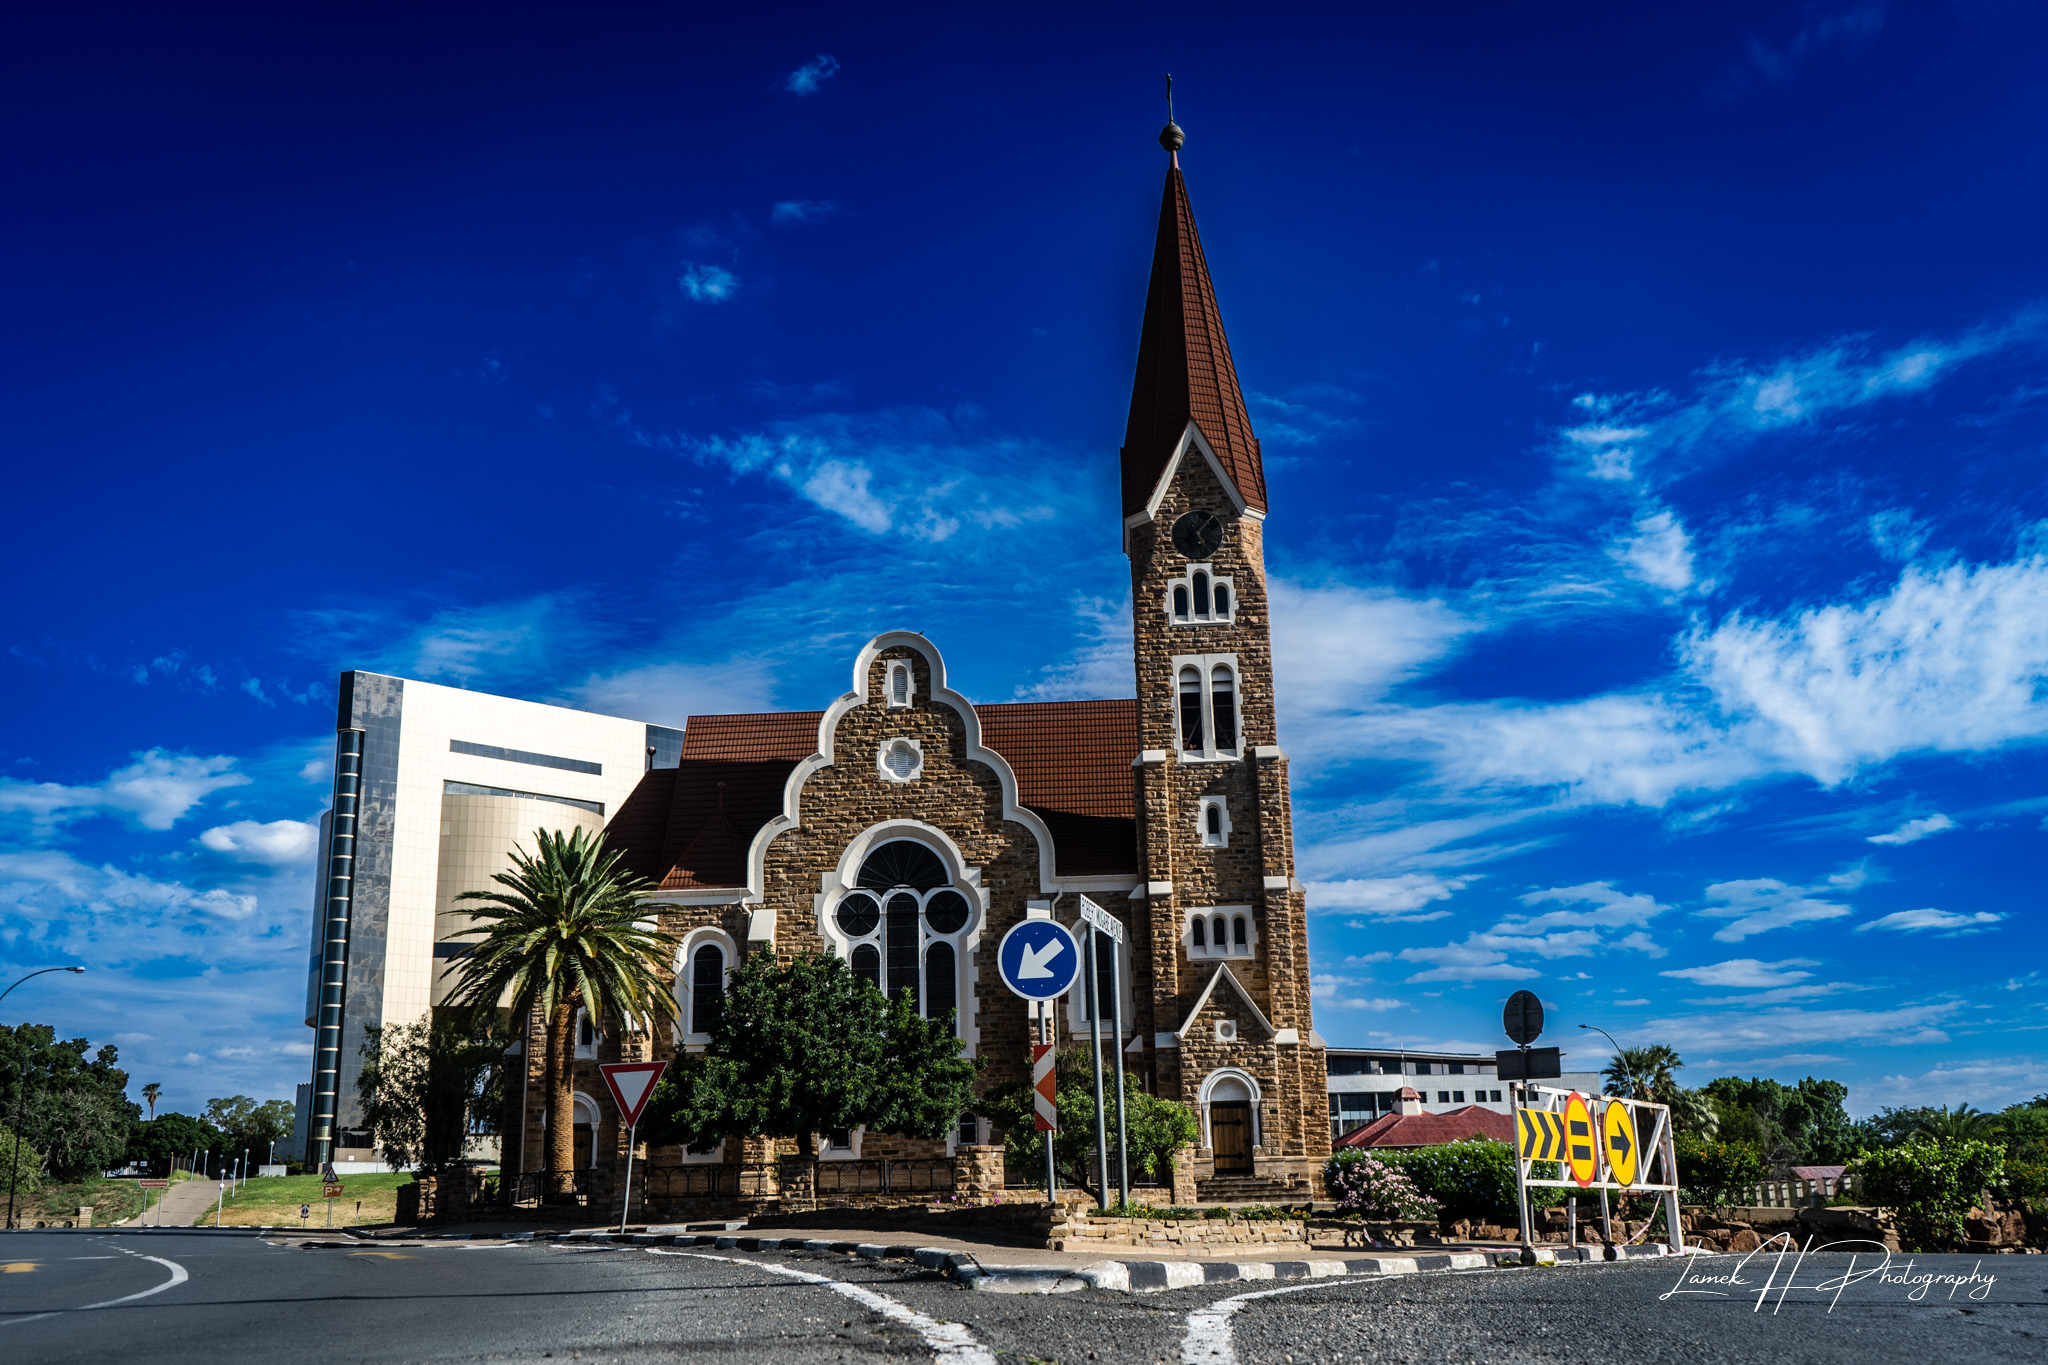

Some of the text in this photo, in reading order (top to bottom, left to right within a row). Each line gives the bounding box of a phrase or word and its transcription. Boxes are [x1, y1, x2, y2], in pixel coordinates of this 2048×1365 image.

[1082, 897, 1121, 940] ROBERT MUGABE AVENUE
[325, 1187, 333, 1196] P
